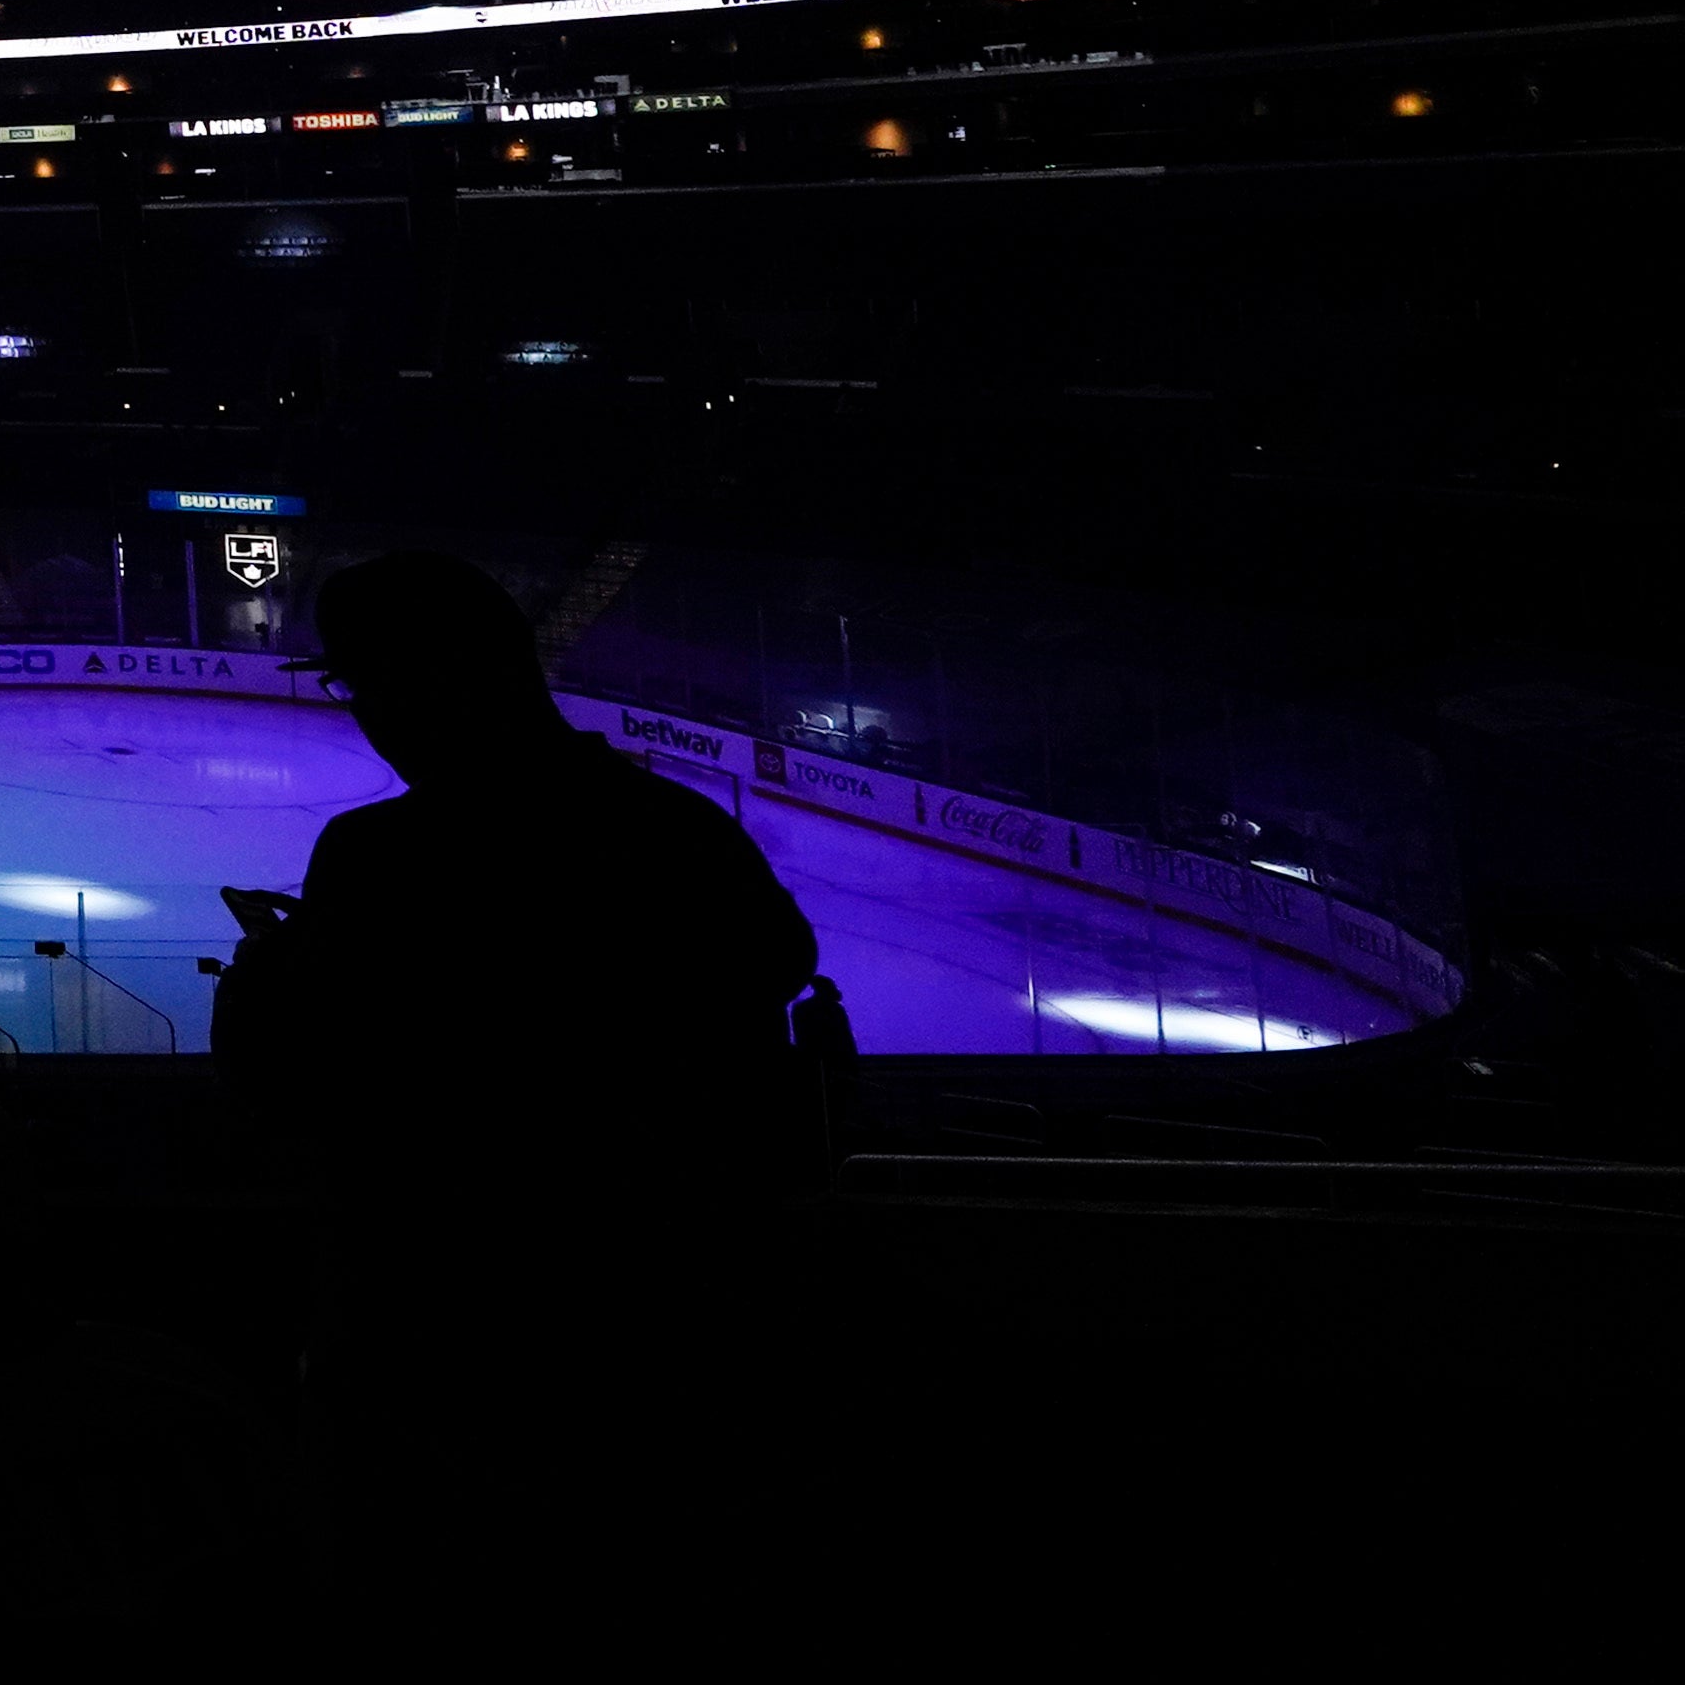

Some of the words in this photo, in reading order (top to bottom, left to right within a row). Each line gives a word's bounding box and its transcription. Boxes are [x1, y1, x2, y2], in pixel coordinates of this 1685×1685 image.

[177, 26, 286, 47] WELCOME
[292, 21, 354, 40] BACK
[500, 105, 529, 121] LA
[532, 101, 598, 120] KINGS
[656, 94, 726, 109] DELTA
[182, 121, 207, 136] LA
[209, 118, 267, 135] KINGS
[293, 113, 379, 129] TOSHIBA
[179, 494, 218, 509] BUD
[219, 496, 274, 512] LIGHT
[230, 541, 274, 559] LA
[118, 654, 234, 678] DELTA
[621, 708, 723, 762] betway
[794, 761, 876, 800] TOYOTA
